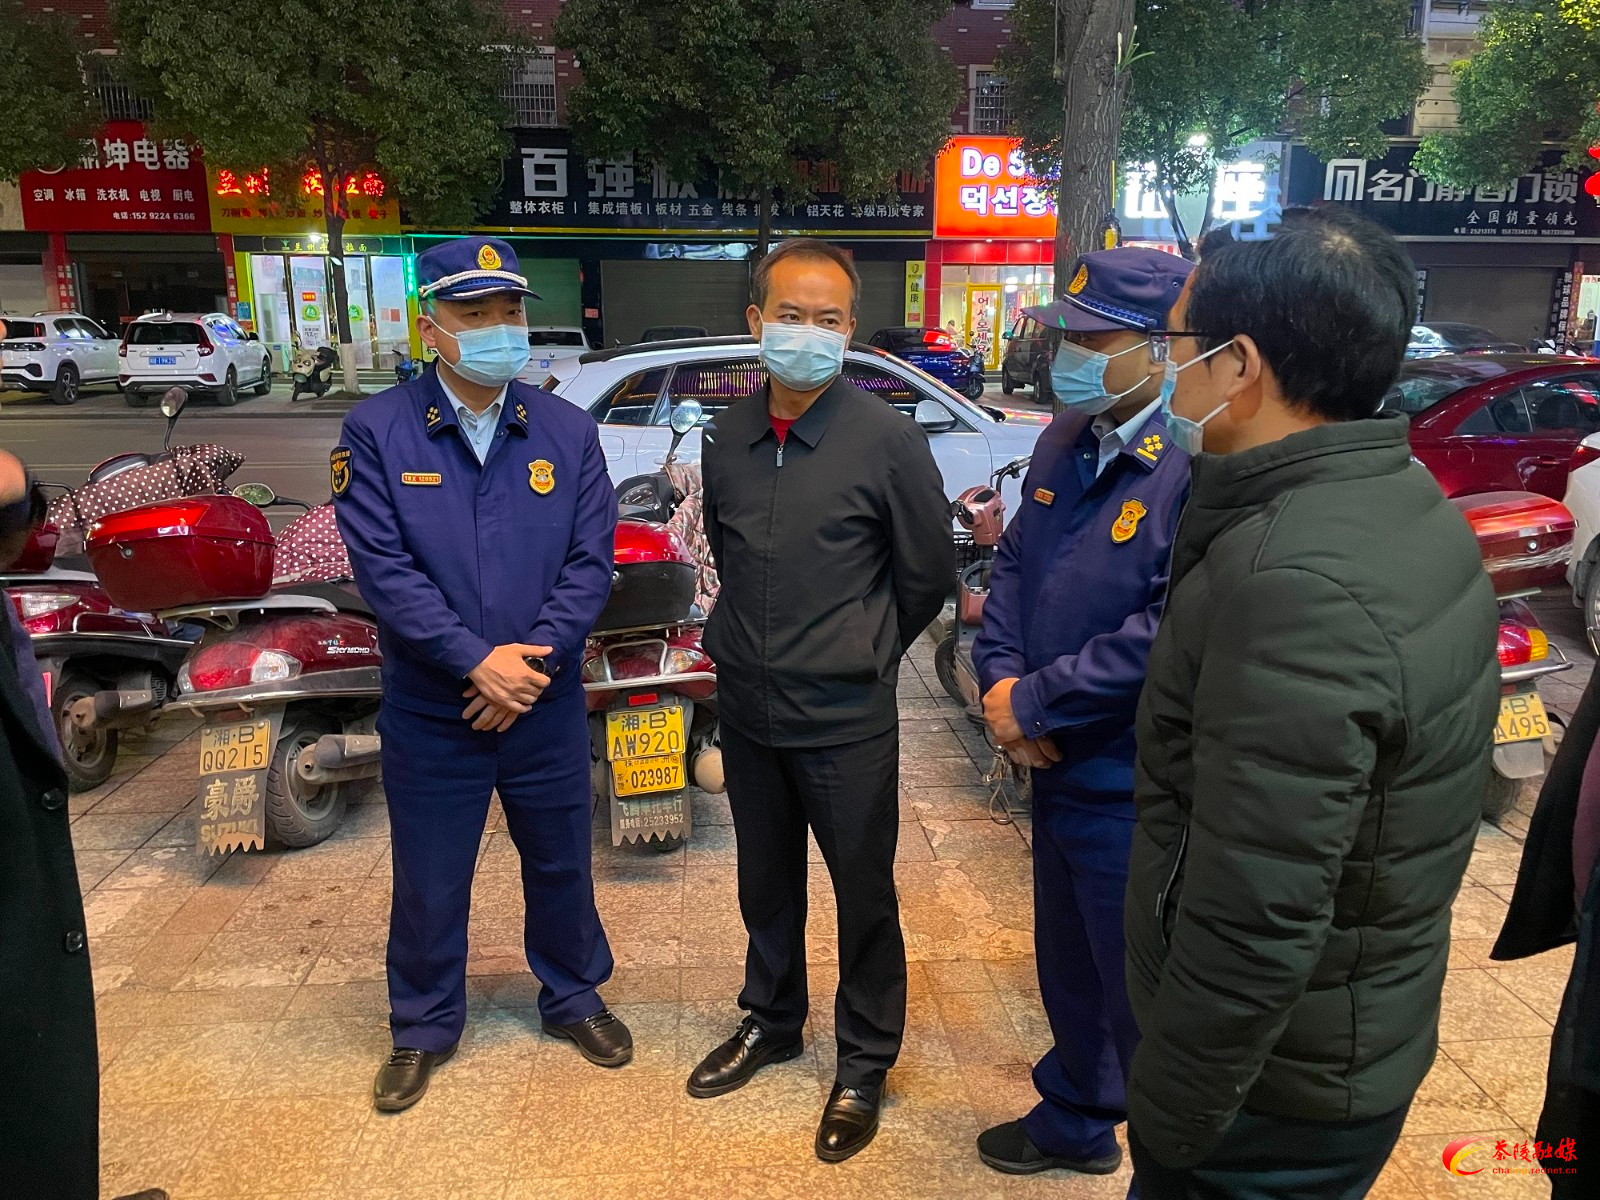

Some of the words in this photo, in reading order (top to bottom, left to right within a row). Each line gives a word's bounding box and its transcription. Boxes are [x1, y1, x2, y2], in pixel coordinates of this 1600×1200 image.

[961, 148, 1001, 178] De
[33, 188, 54, 202] 空调
[64, 188, 86, 202] 冰箱
[96, 188, 129, 202] 洗衣机
[139, 189, 161, 202] 电视
[149, 211, 171, 221] 9224
[509, 201, 565, 215] 整体衣柜
[587, 202, 643, 216] 集成墙板
[654, 202, 682, 216] 板材
[688, 203, 714, 217] 五金
[721, 202, 748, 217] 线条
[806, 204, 845, 218] 铝天花
[1466, 209, 1578, 226] 全国销量领先
[910, 282, 920, 303] 健康
[203, 744, 263, 772] QQ215
[200, 775, 260, 821] 豪爵
